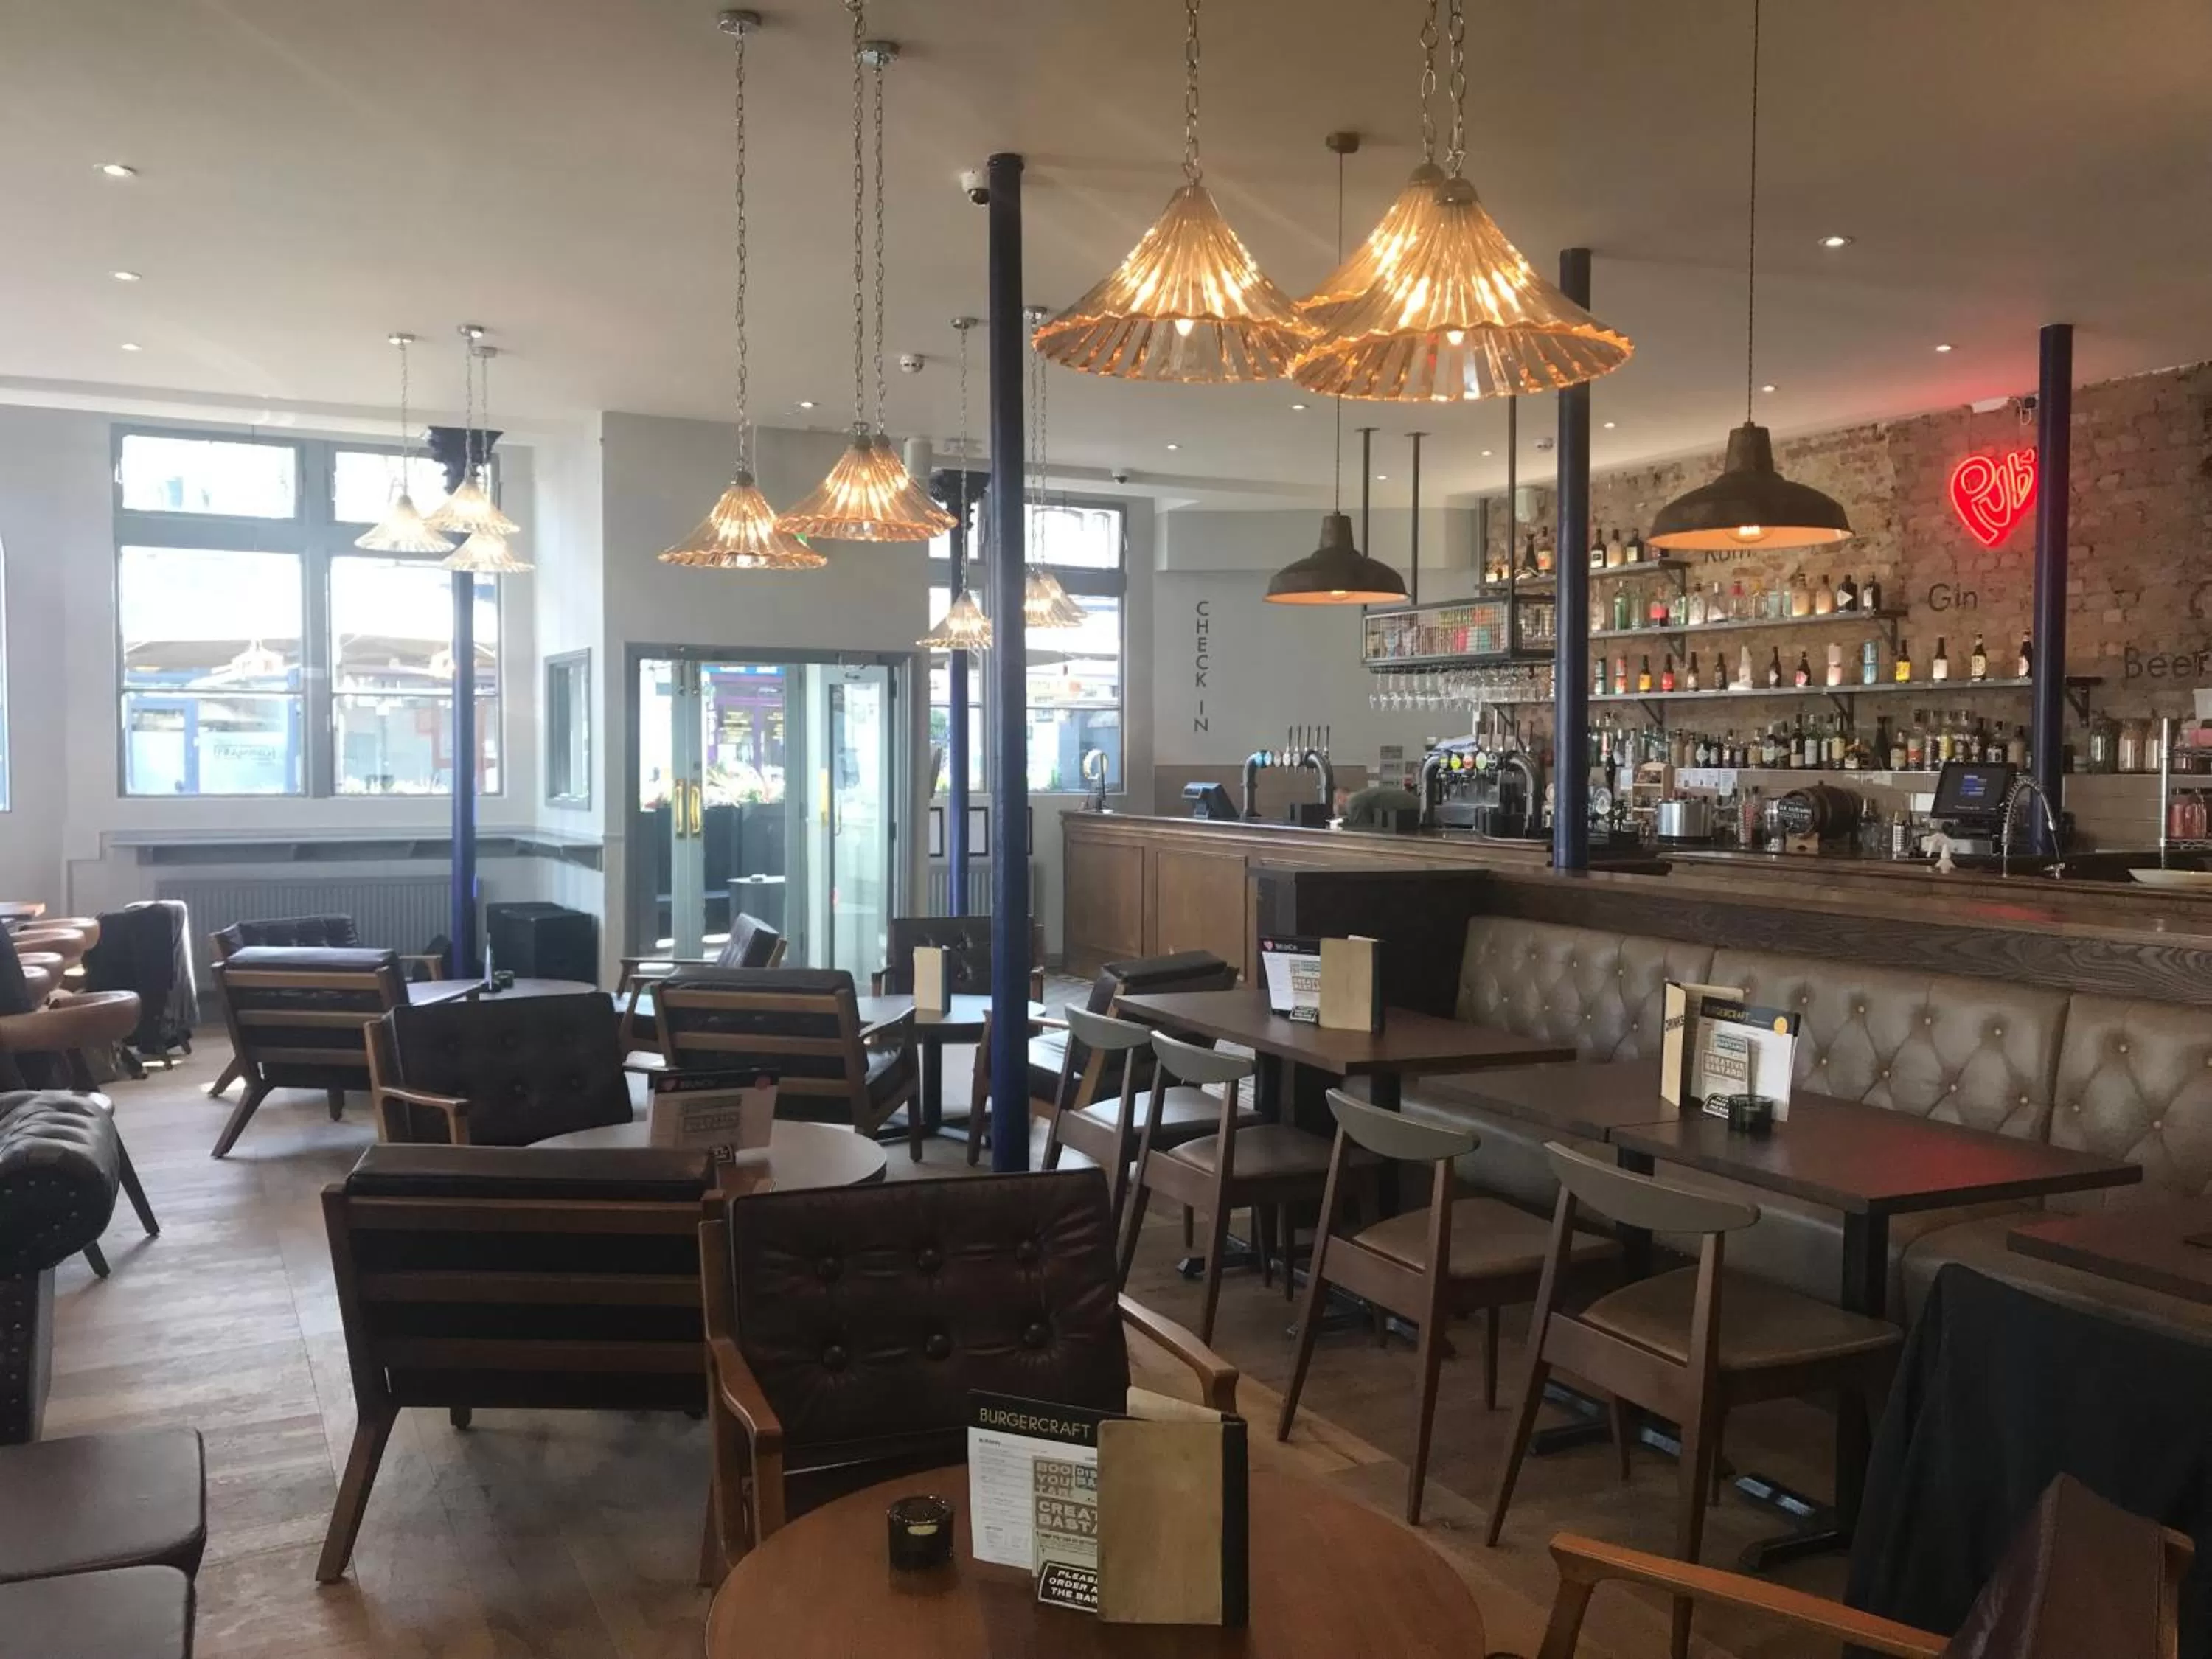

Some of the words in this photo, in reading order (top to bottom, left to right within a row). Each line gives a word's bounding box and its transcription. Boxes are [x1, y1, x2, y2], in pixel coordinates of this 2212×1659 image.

[1928, 582, 1978, 611] Gin
[1195, 600, 1209, 687] CHECK
[2124, 647, 2210, 679] Beer
[1194, 700, 1208, 732] IN
[979, 1408, 1091, 1438] BURGERCRAFT
[1049, 1577, 1088, 1592] ORDER
[1051, 1586, 1073, 1598] THE
